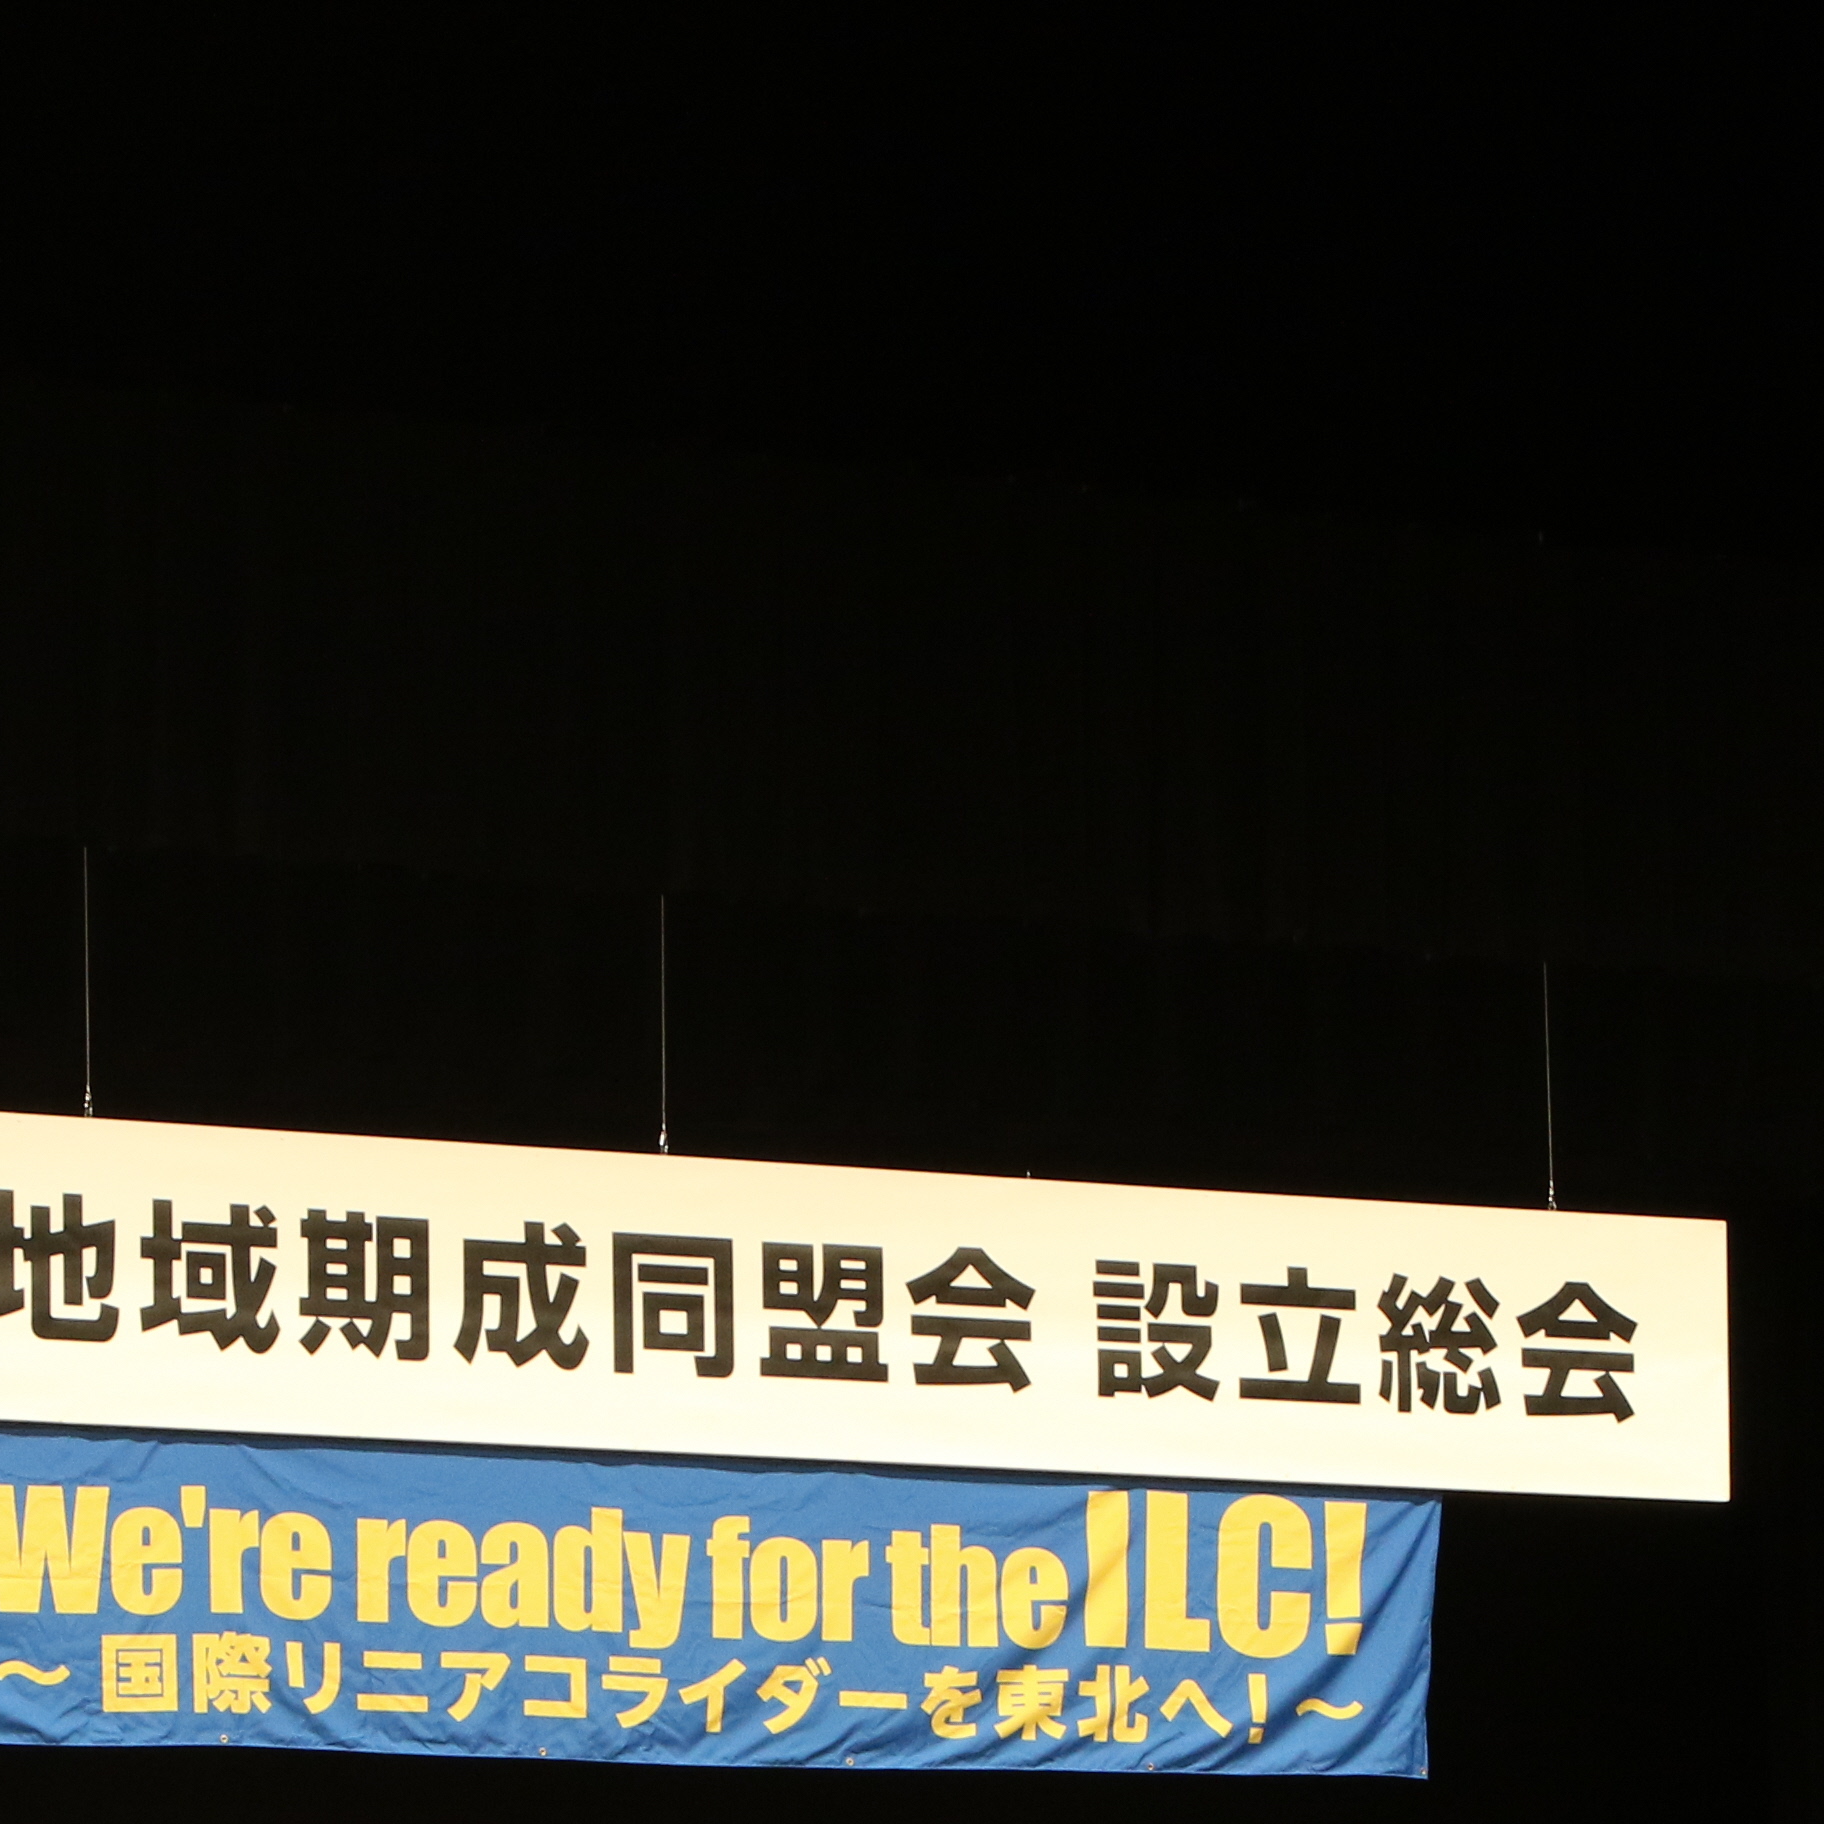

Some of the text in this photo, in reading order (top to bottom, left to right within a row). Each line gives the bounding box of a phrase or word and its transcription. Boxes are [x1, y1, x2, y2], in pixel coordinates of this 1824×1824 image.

[1091, 1257, 1639, 1423] 設立総会
[358, 1507, 693, 1653] ready
[706, 1516, 871, 1645] for
[885, 1524, 1069, 1650] the
[1082, 1490, 1370, 1660] ILC!
